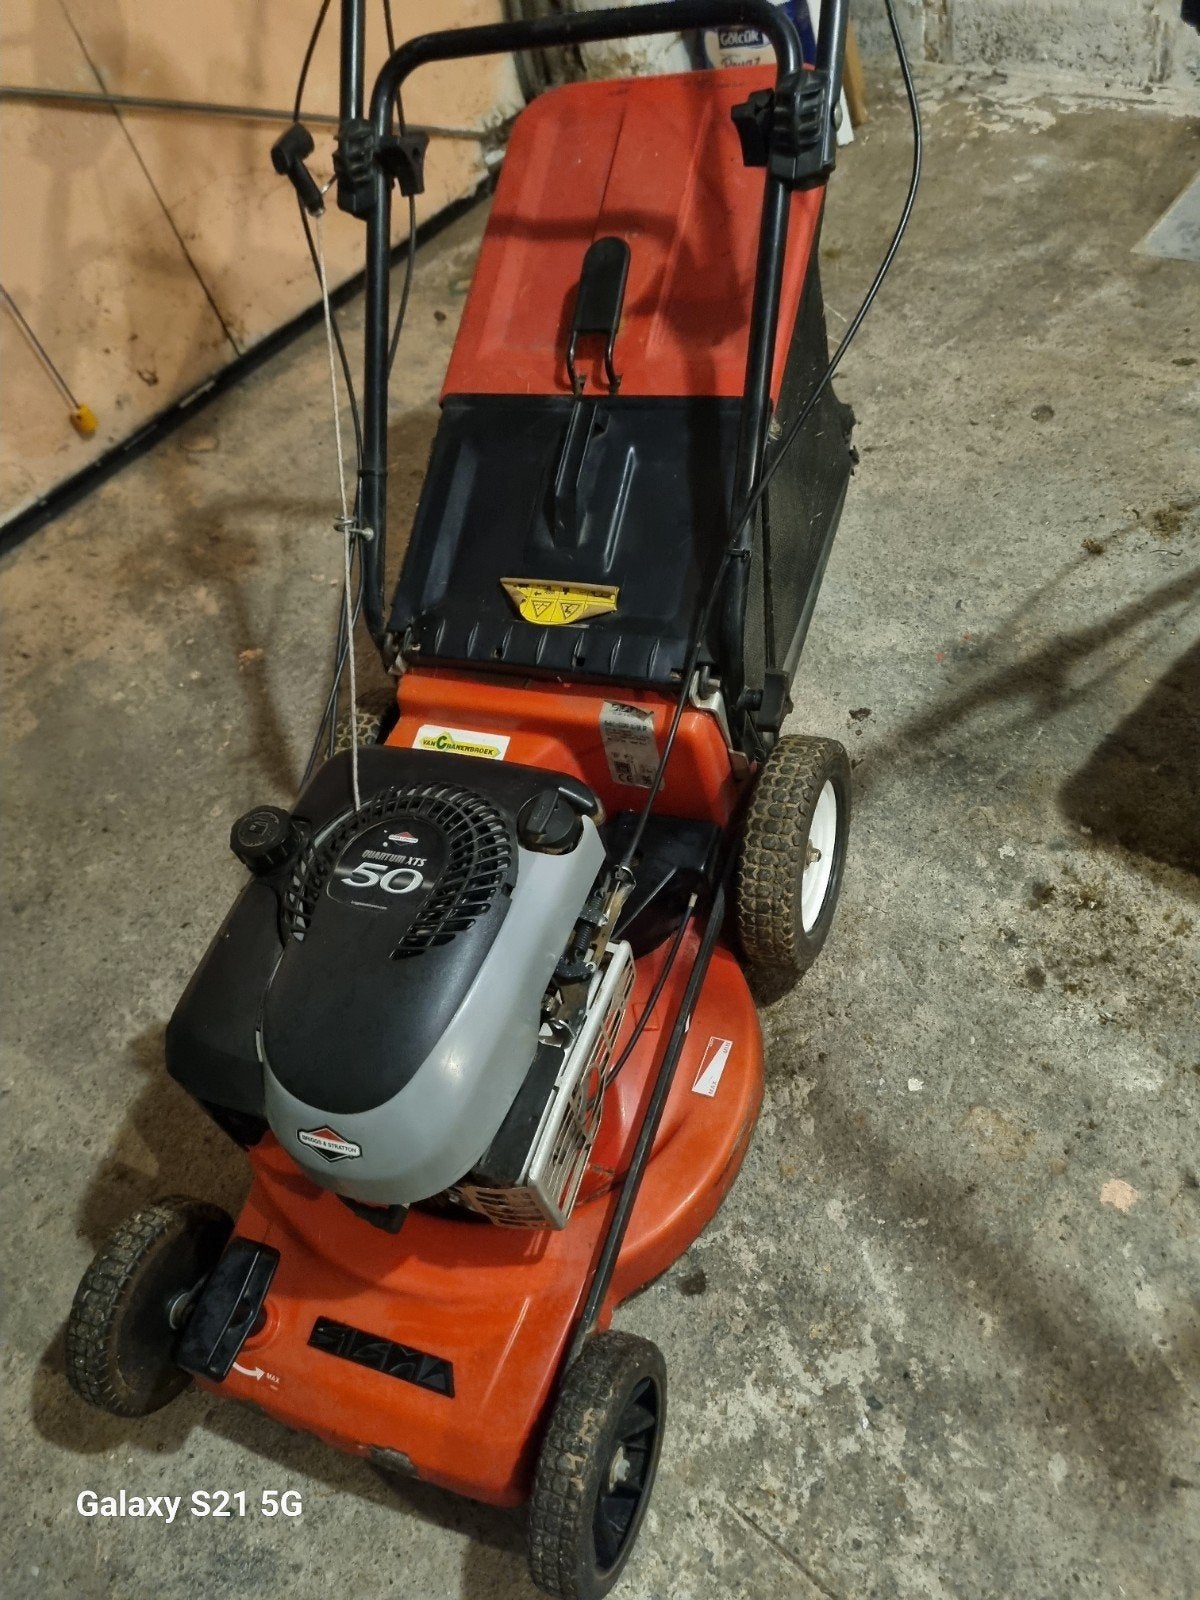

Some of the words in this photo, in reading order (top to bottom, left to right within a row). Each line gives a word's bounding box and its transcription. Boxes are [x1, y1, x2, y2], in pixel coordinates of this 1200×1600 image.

[422, 738, 436, 748] VAN
[361, 849, 407, 864] QUANTUM
[406, 856, 428, 867] XTS
[340, 861, 424, 894] 50
[327, 1142, 357, 1154] STRATTON
[266, 1372, 280, 1384] MAX
